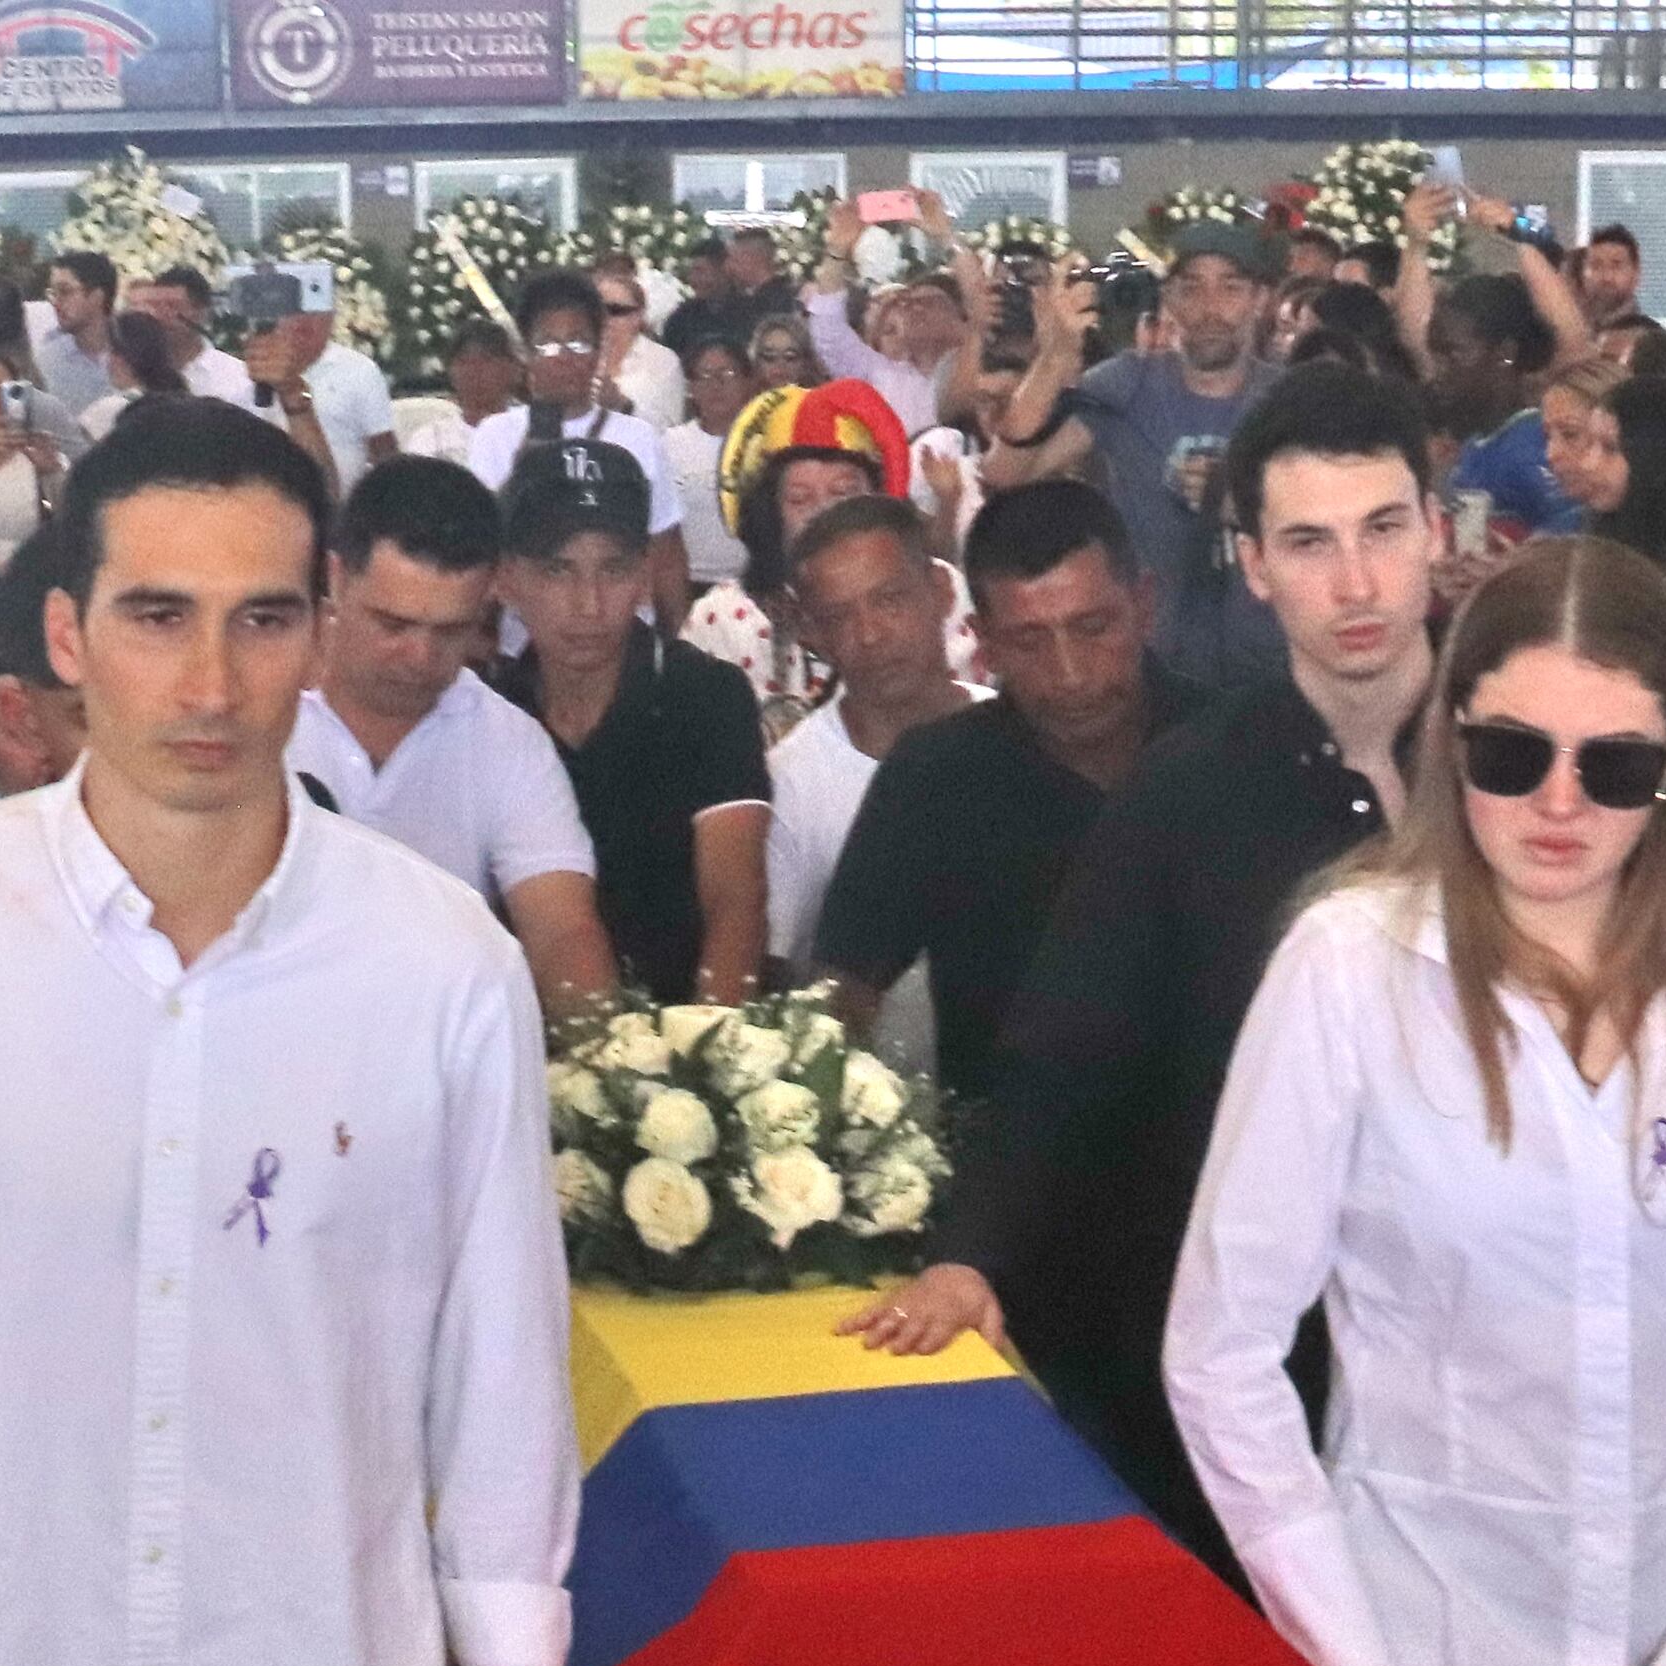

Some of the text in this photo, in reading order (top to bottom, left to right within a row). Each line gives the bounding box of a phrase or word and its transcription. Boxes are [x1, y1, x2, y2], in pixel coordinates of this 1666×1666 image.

[372, 10, 549, 29] TRISTAN SALOON
[2, 58, 102, 79] CENTRO
[20, 79, 117, 98] EVENTOS
